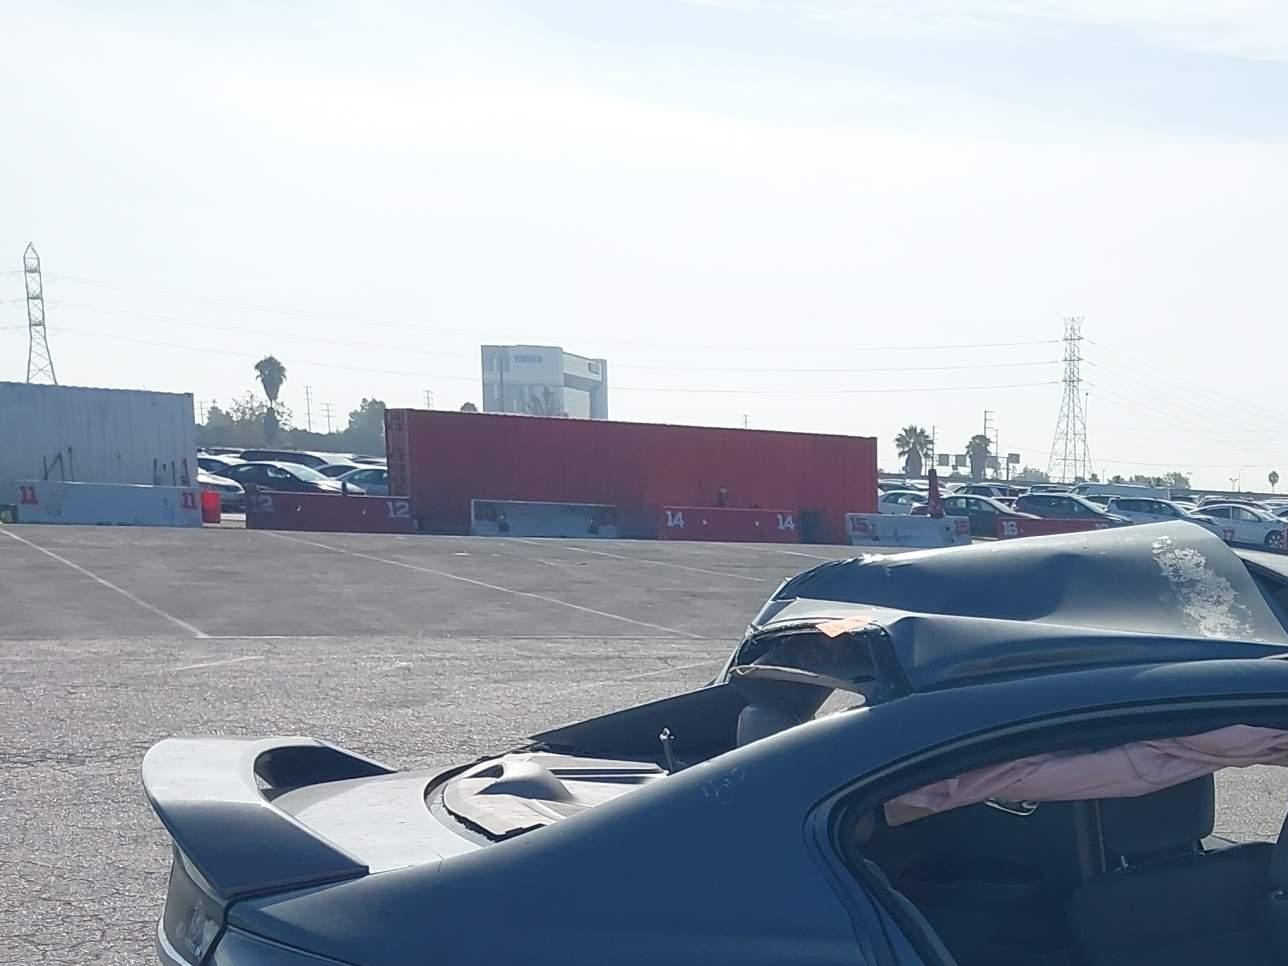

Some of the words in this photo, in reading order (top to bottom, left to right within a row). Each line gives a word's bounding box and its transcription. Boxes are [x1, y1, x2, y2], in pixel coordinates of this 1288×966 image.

[19, 485, 39, 505] 11
[181, 492, 198, 510] 11
[386, 501, 410, 519] 12
[665, 510, 685, 528] 14
[777, 513, 796, 531] 14
[849, 516, 868, 533] 15
